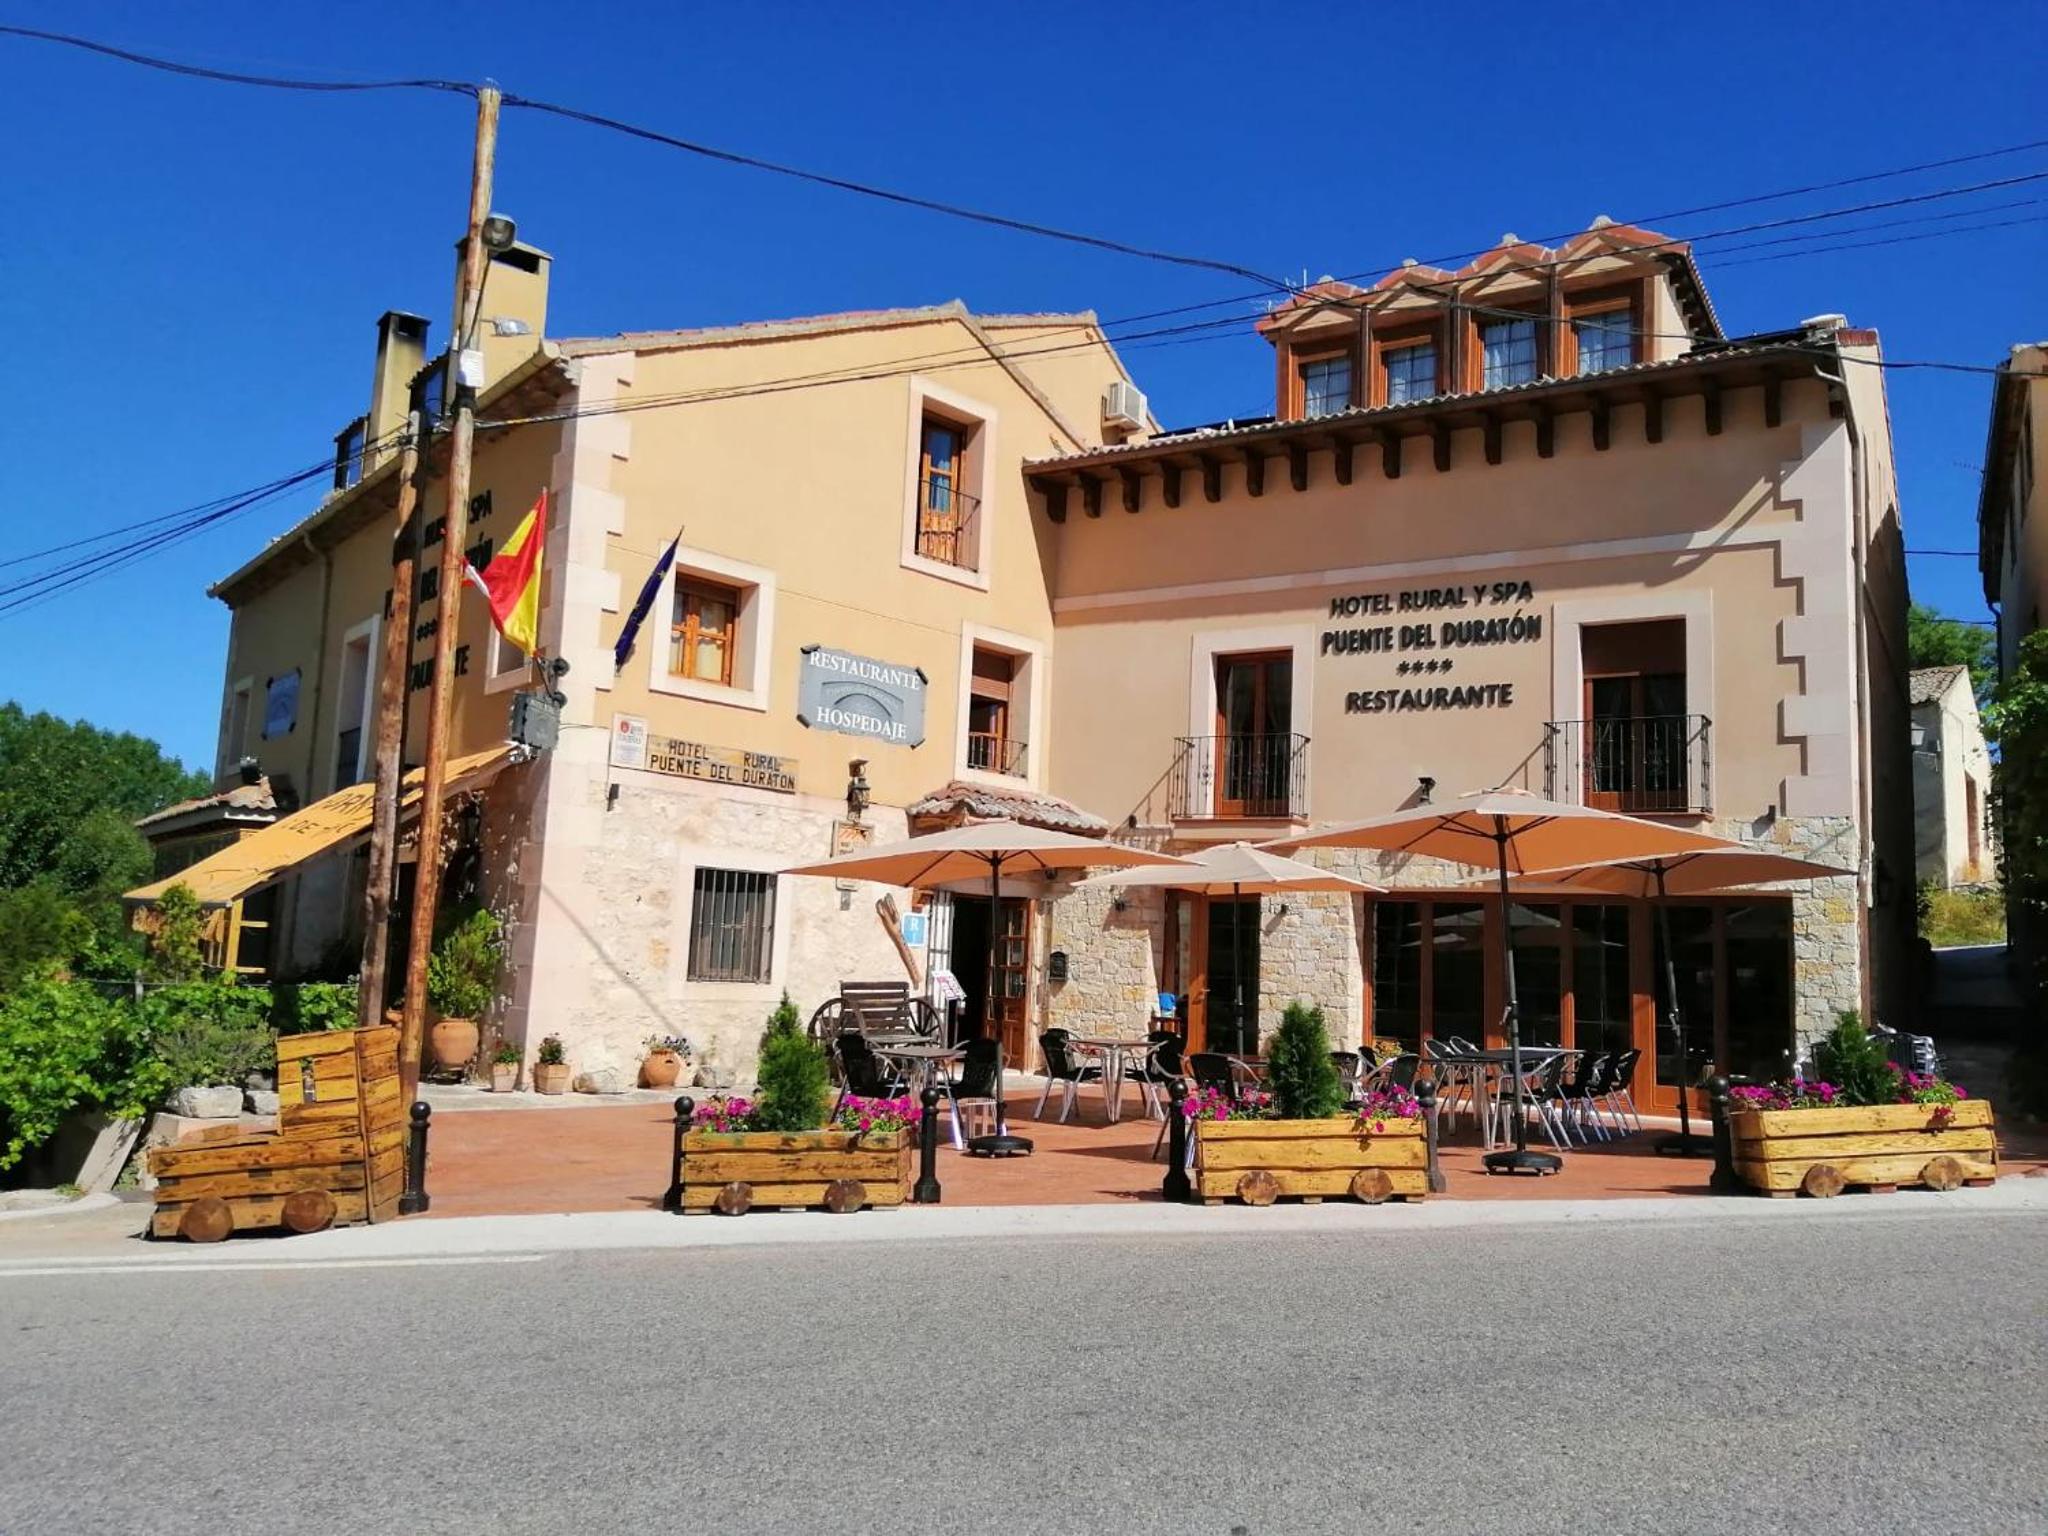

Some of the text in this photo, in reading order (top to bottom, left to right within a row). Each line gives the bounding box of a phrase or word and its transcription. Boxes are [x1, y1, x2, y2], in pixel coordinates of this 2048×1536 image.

[1330, 580, 1534, 618] HOTEL RURAL Y SPA
[1321, 608, 1542, 656] PUENTE DEL DURATÓN
[809, 650, 921, 691] RESTAURANTE
[1345, 683, 1514, 714] RESTAURANTE
[817, 706, 908, 741] HOSPEDAJE
[650, 754, 701, 776] PUENTE
[710, 764, 733, 781] DEL
[742, 769, 796, 789] DURATON
[668, 739, 781, 772] HOTEL RURAL
